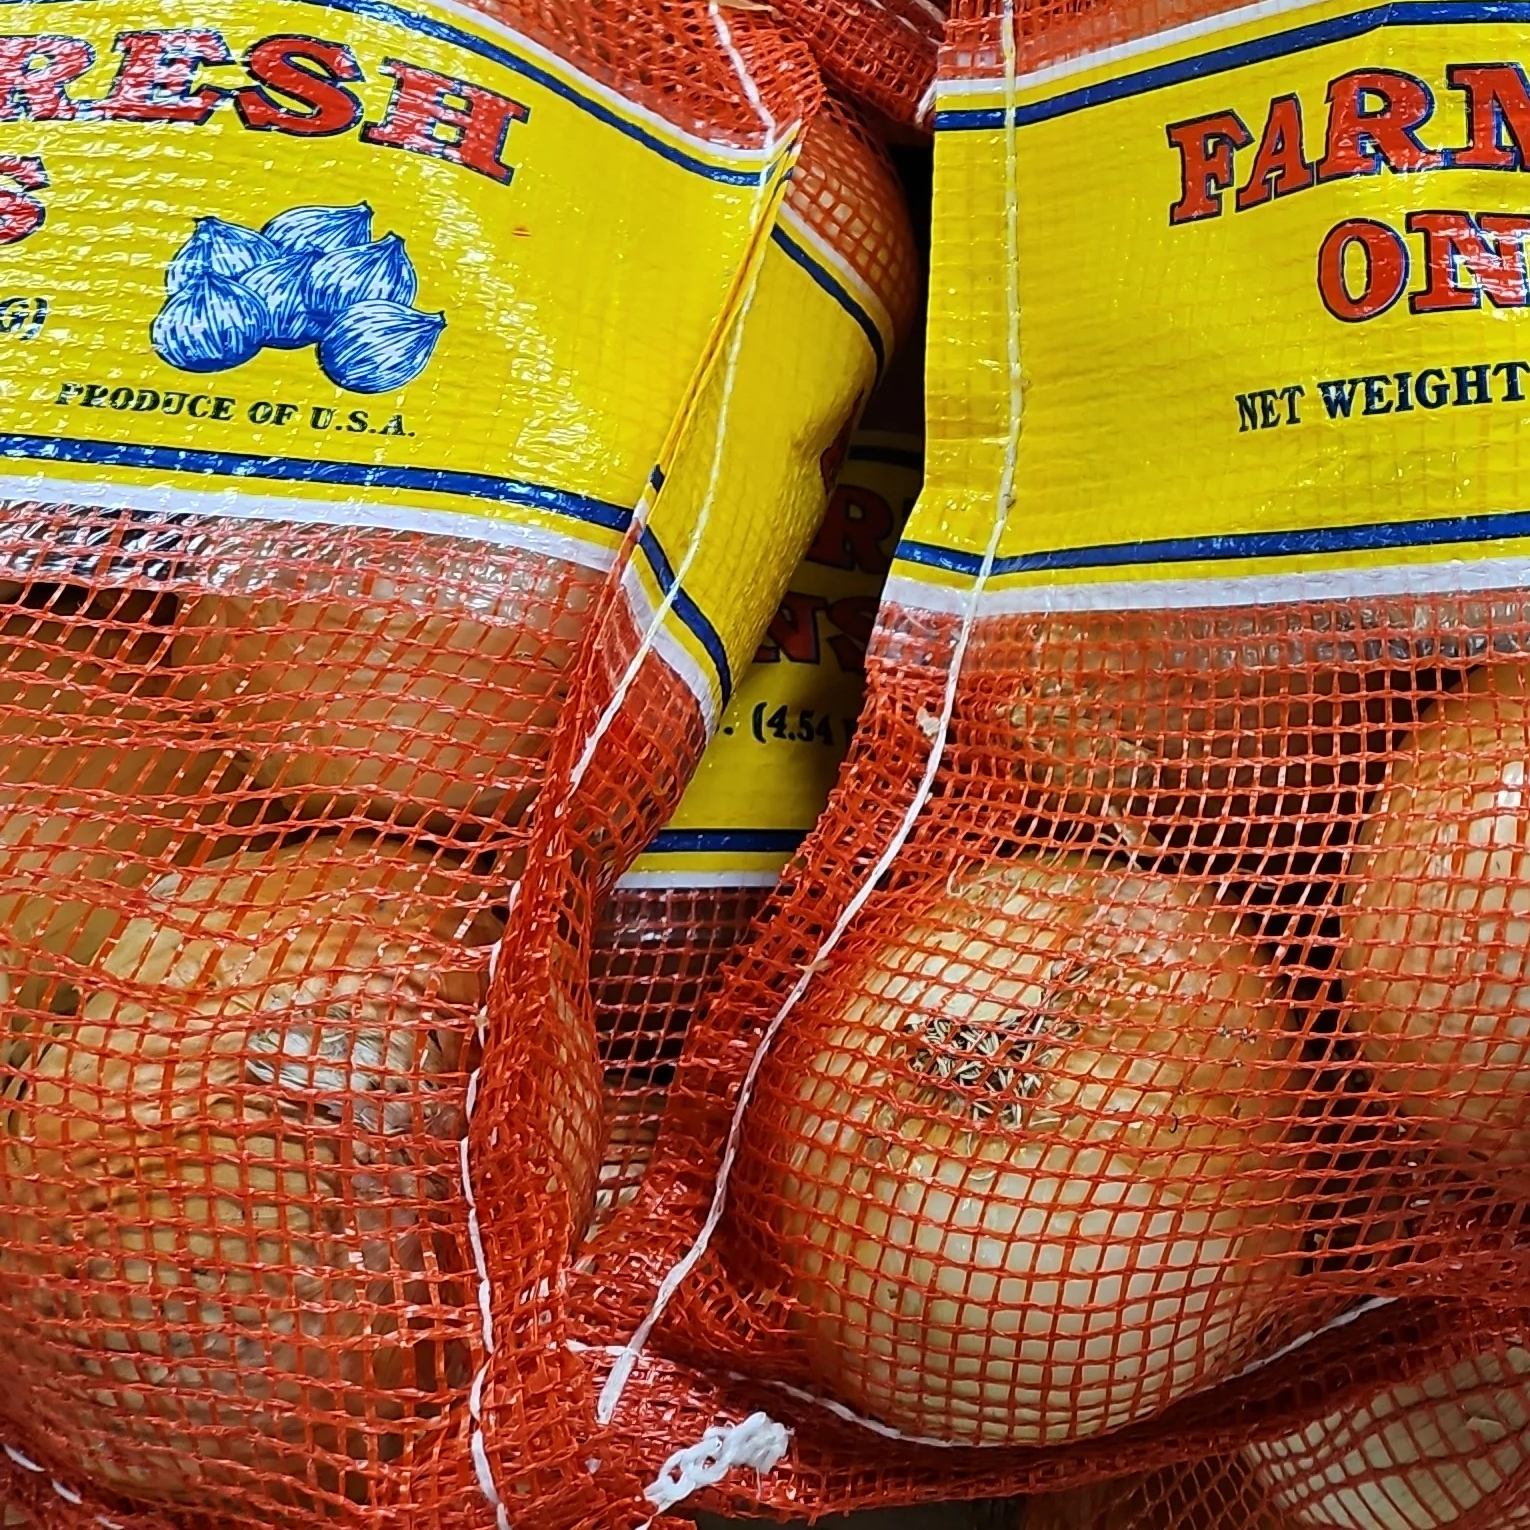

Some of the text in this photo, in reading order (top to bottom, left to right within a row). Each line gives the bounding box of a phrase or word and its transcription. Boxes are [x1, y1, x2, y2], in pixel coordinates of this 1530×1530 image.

[56, 382, 416, 438] PRODUCE OF U.S.A.
[1235, 385, 1305, 433] NET
